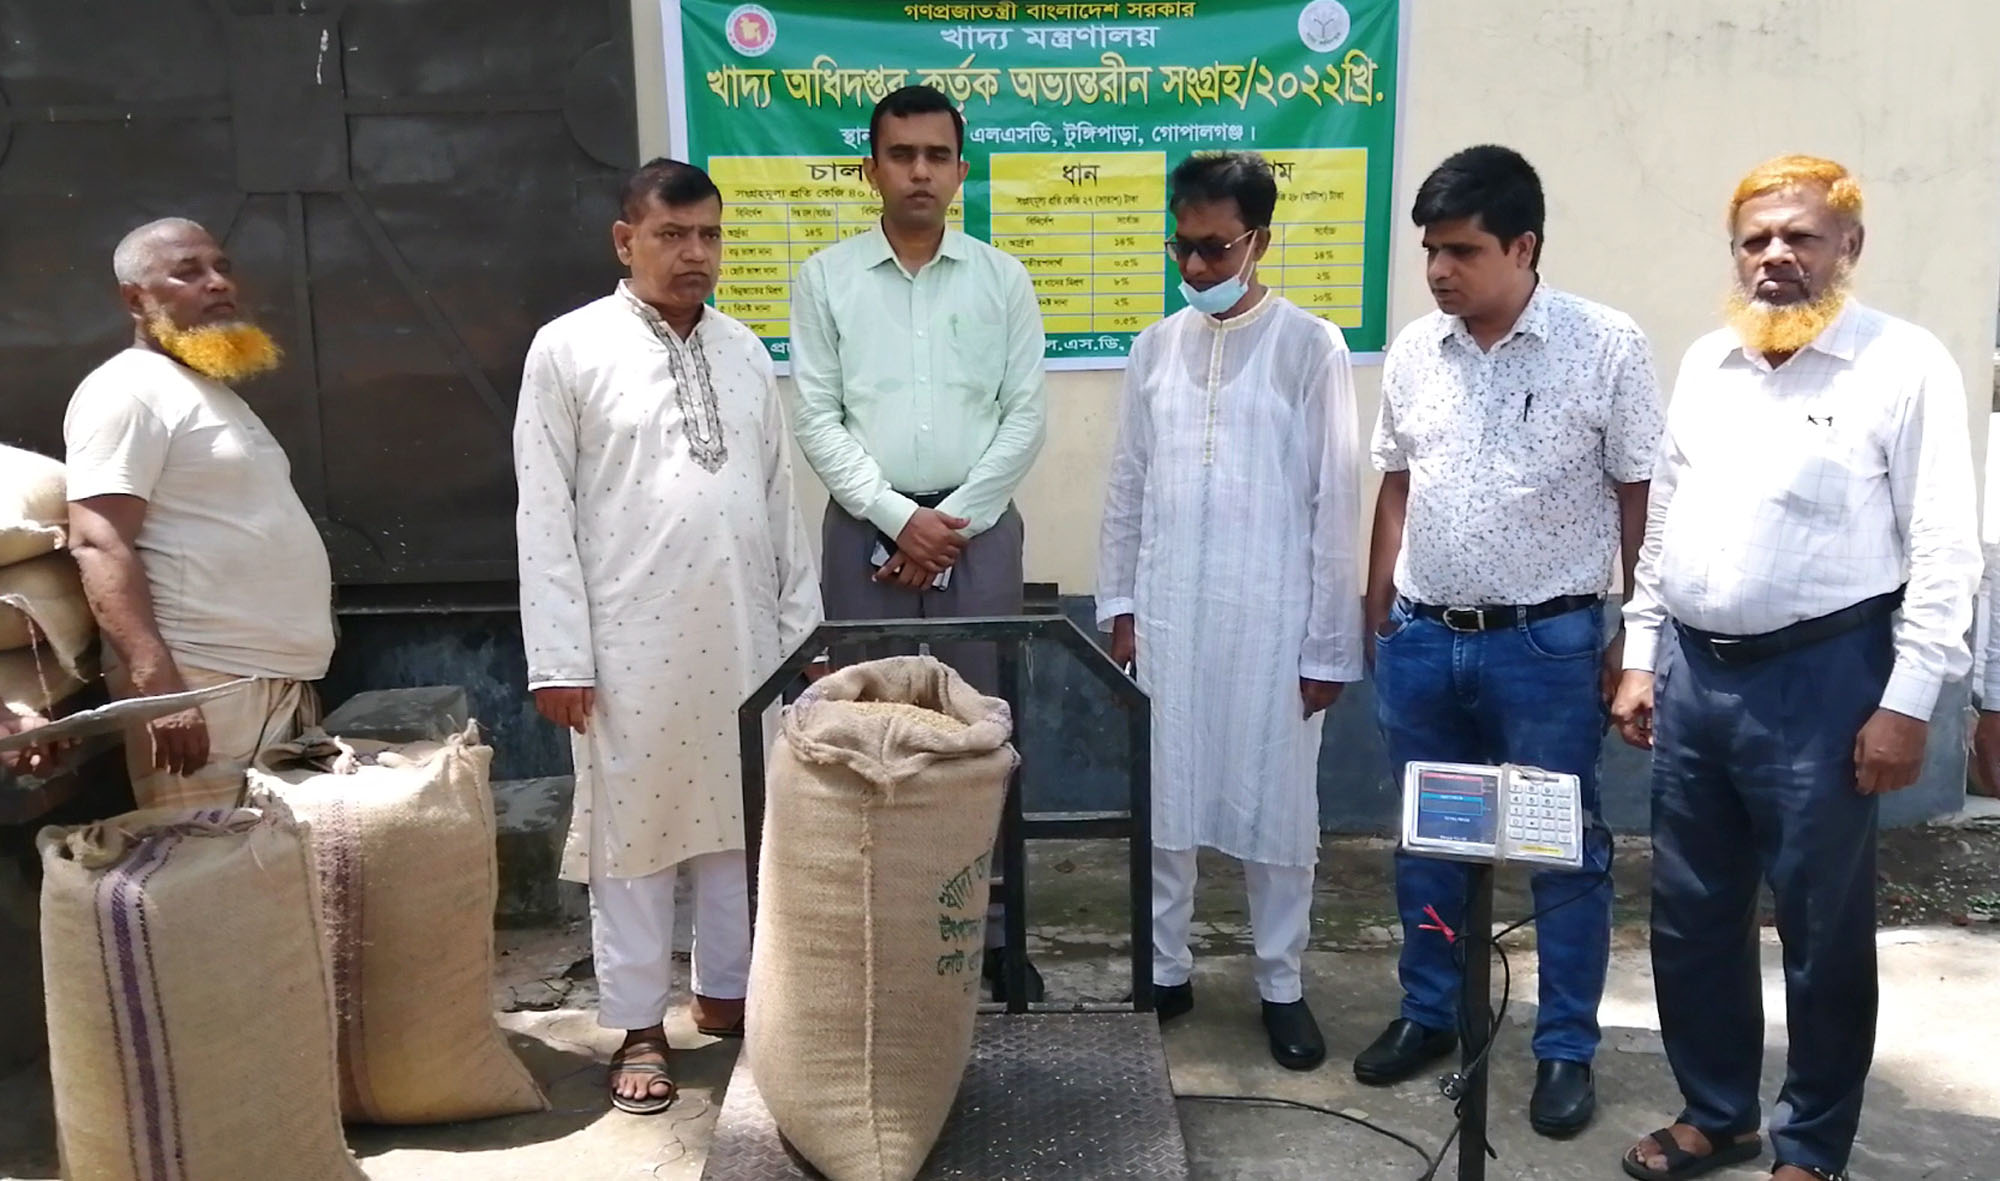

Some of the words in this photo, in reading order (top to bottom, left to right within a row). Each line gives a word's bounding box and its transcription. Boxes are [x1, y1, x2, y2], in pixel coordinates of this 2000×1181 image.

[904, 1, 1017, 21] গণপ্রজাতন্ত্রী
[1026, 1, 1120, 20] বাংলাদেশ
[1127, 1, 1195, 18] সরকার
[940, 25, 1014, 49] খাদ্য
[1022, 24, 1160, 48] মন্ত্রণালয়
[706, 64, 775, 108] খাদ্য
[1009, 52, 1152, 106] অভ্যন্তরীন
[970, 122, 1057, 147] এলএসডি,
[1152, 122, 1243, 143] গোপালগঞ্জ
[806, 162, 863, 182] চাল
[1062, 163, 1100, 187] ধান
[1271, 160, 1296, 183] ম
